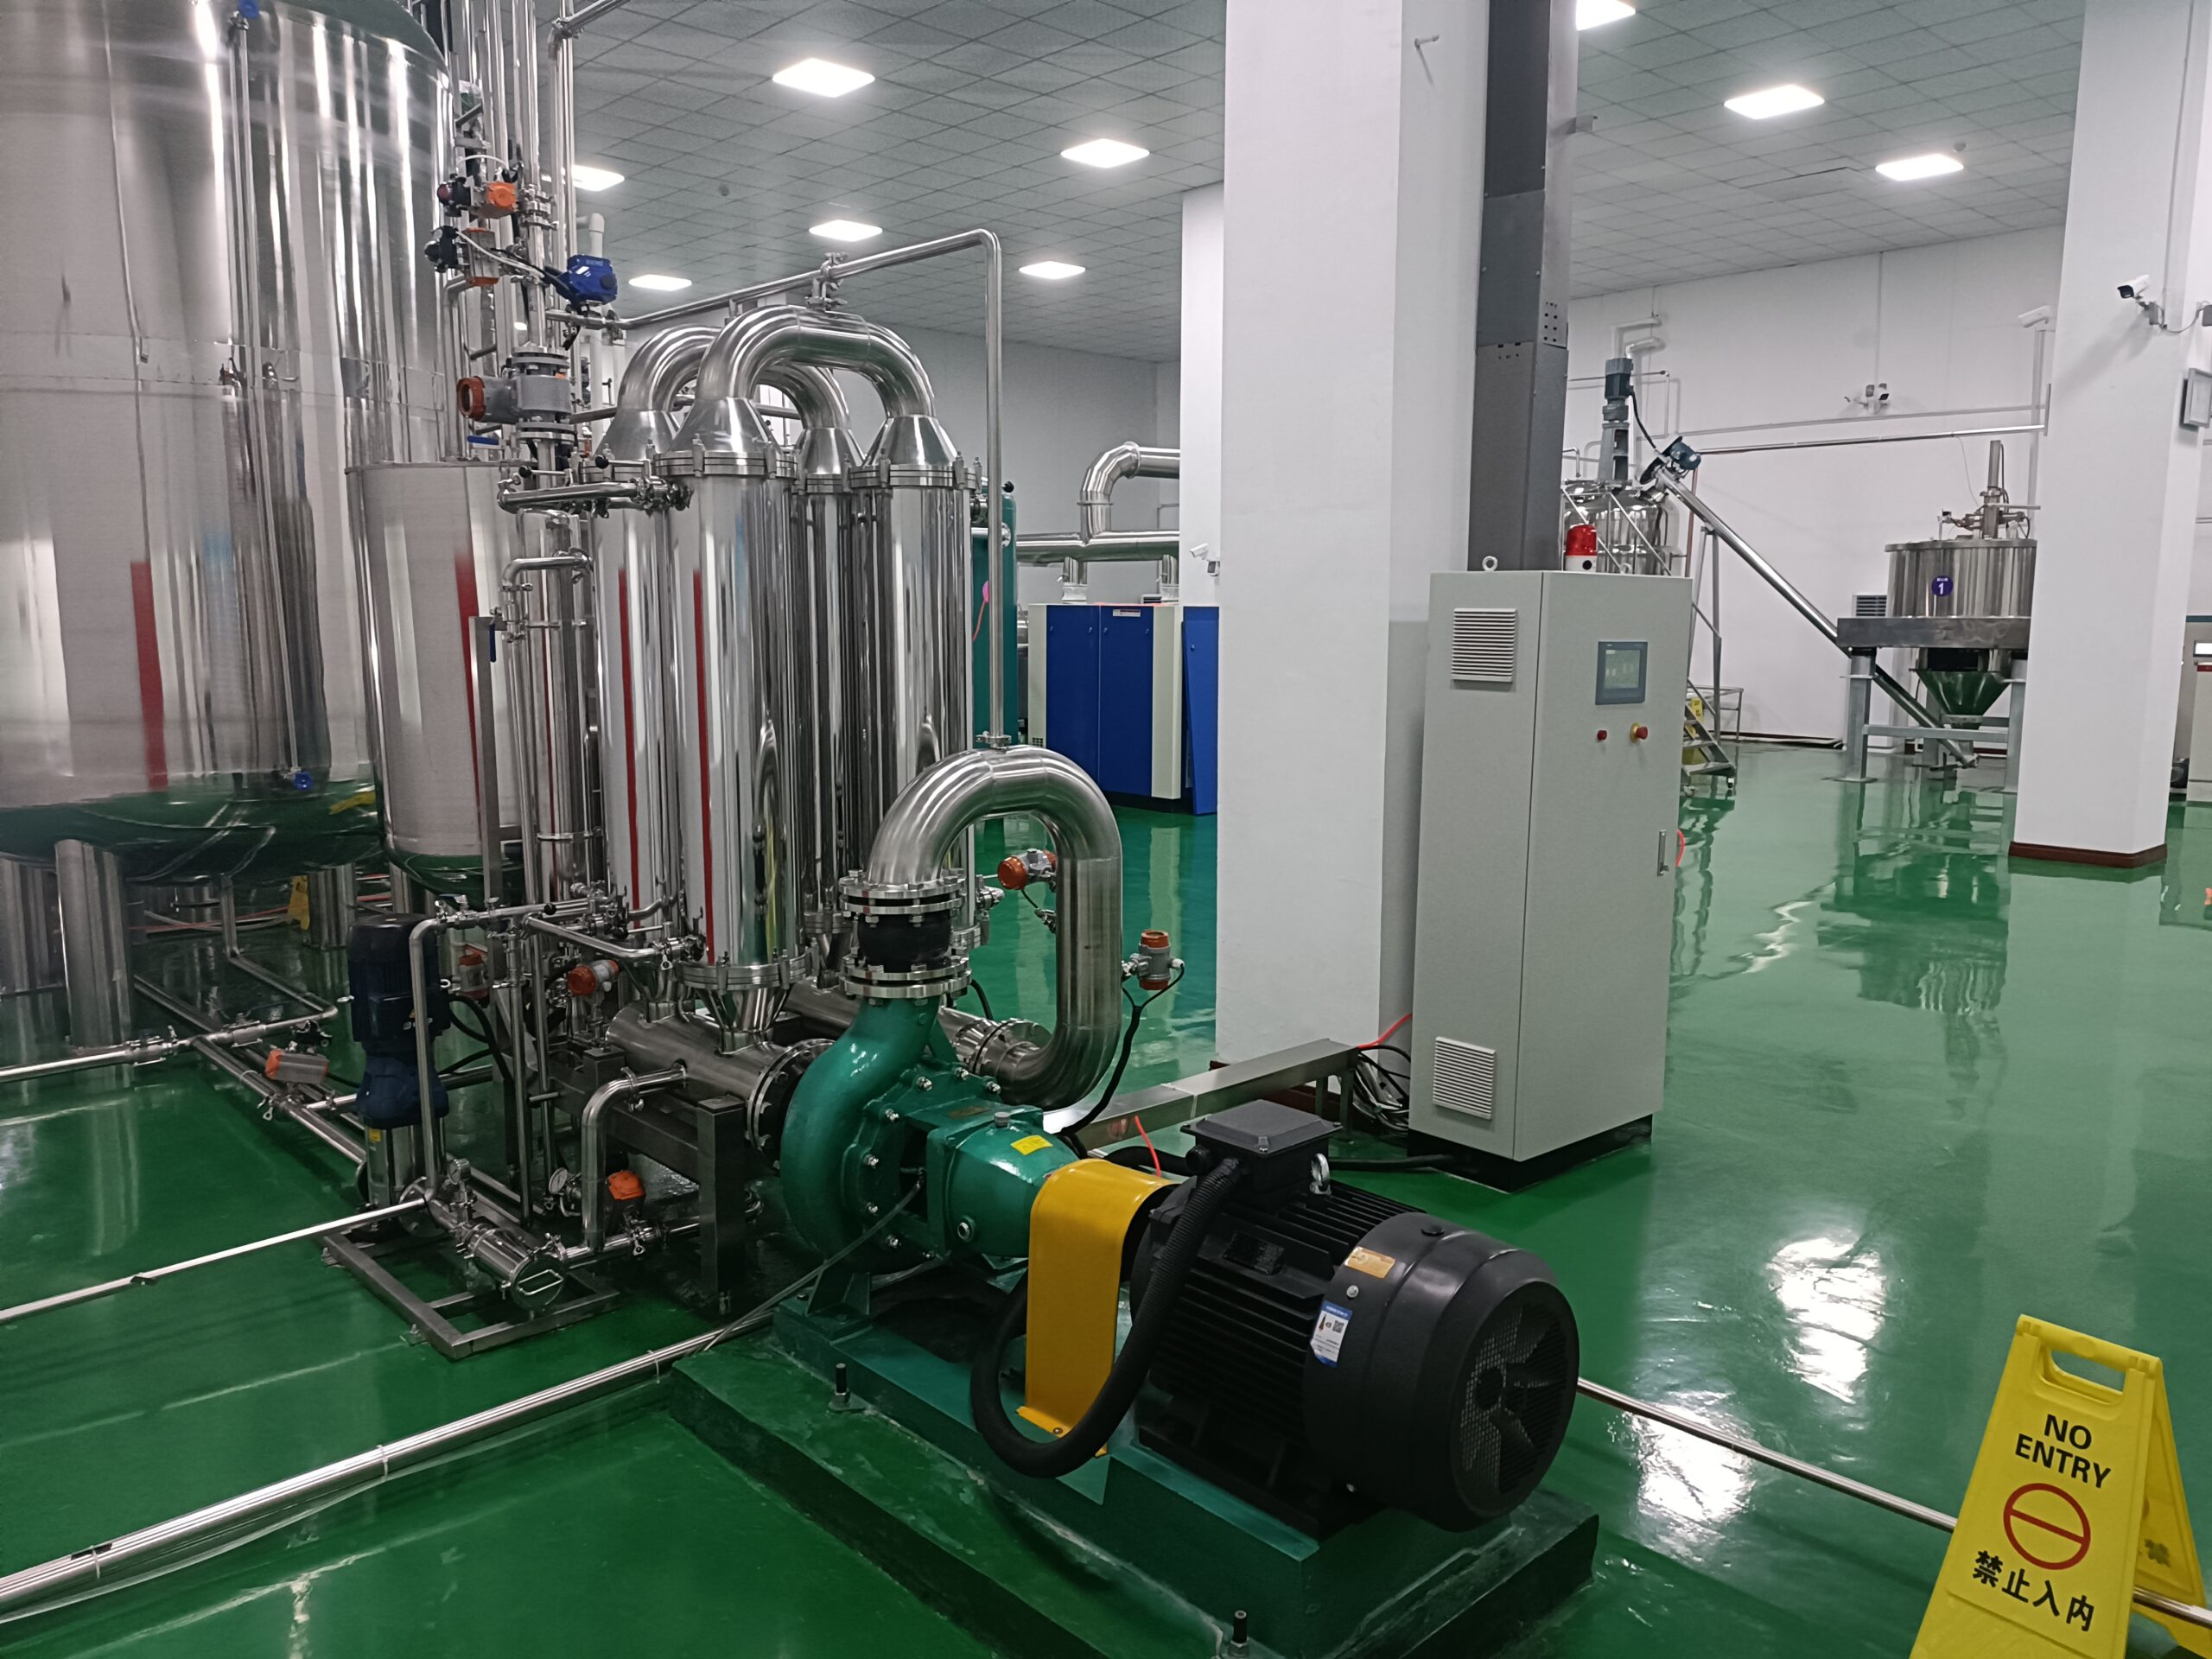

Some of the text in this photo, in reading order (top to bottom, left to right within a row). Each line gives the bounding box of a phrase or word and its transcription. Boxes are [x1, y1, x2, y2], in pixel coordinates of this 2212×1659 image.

[2044, 1414, 2092, 1450] NO
[2015, 1433, 2111, 1489] ENTRY
[1973, 1550, 2094, 1632] 禁止入内
